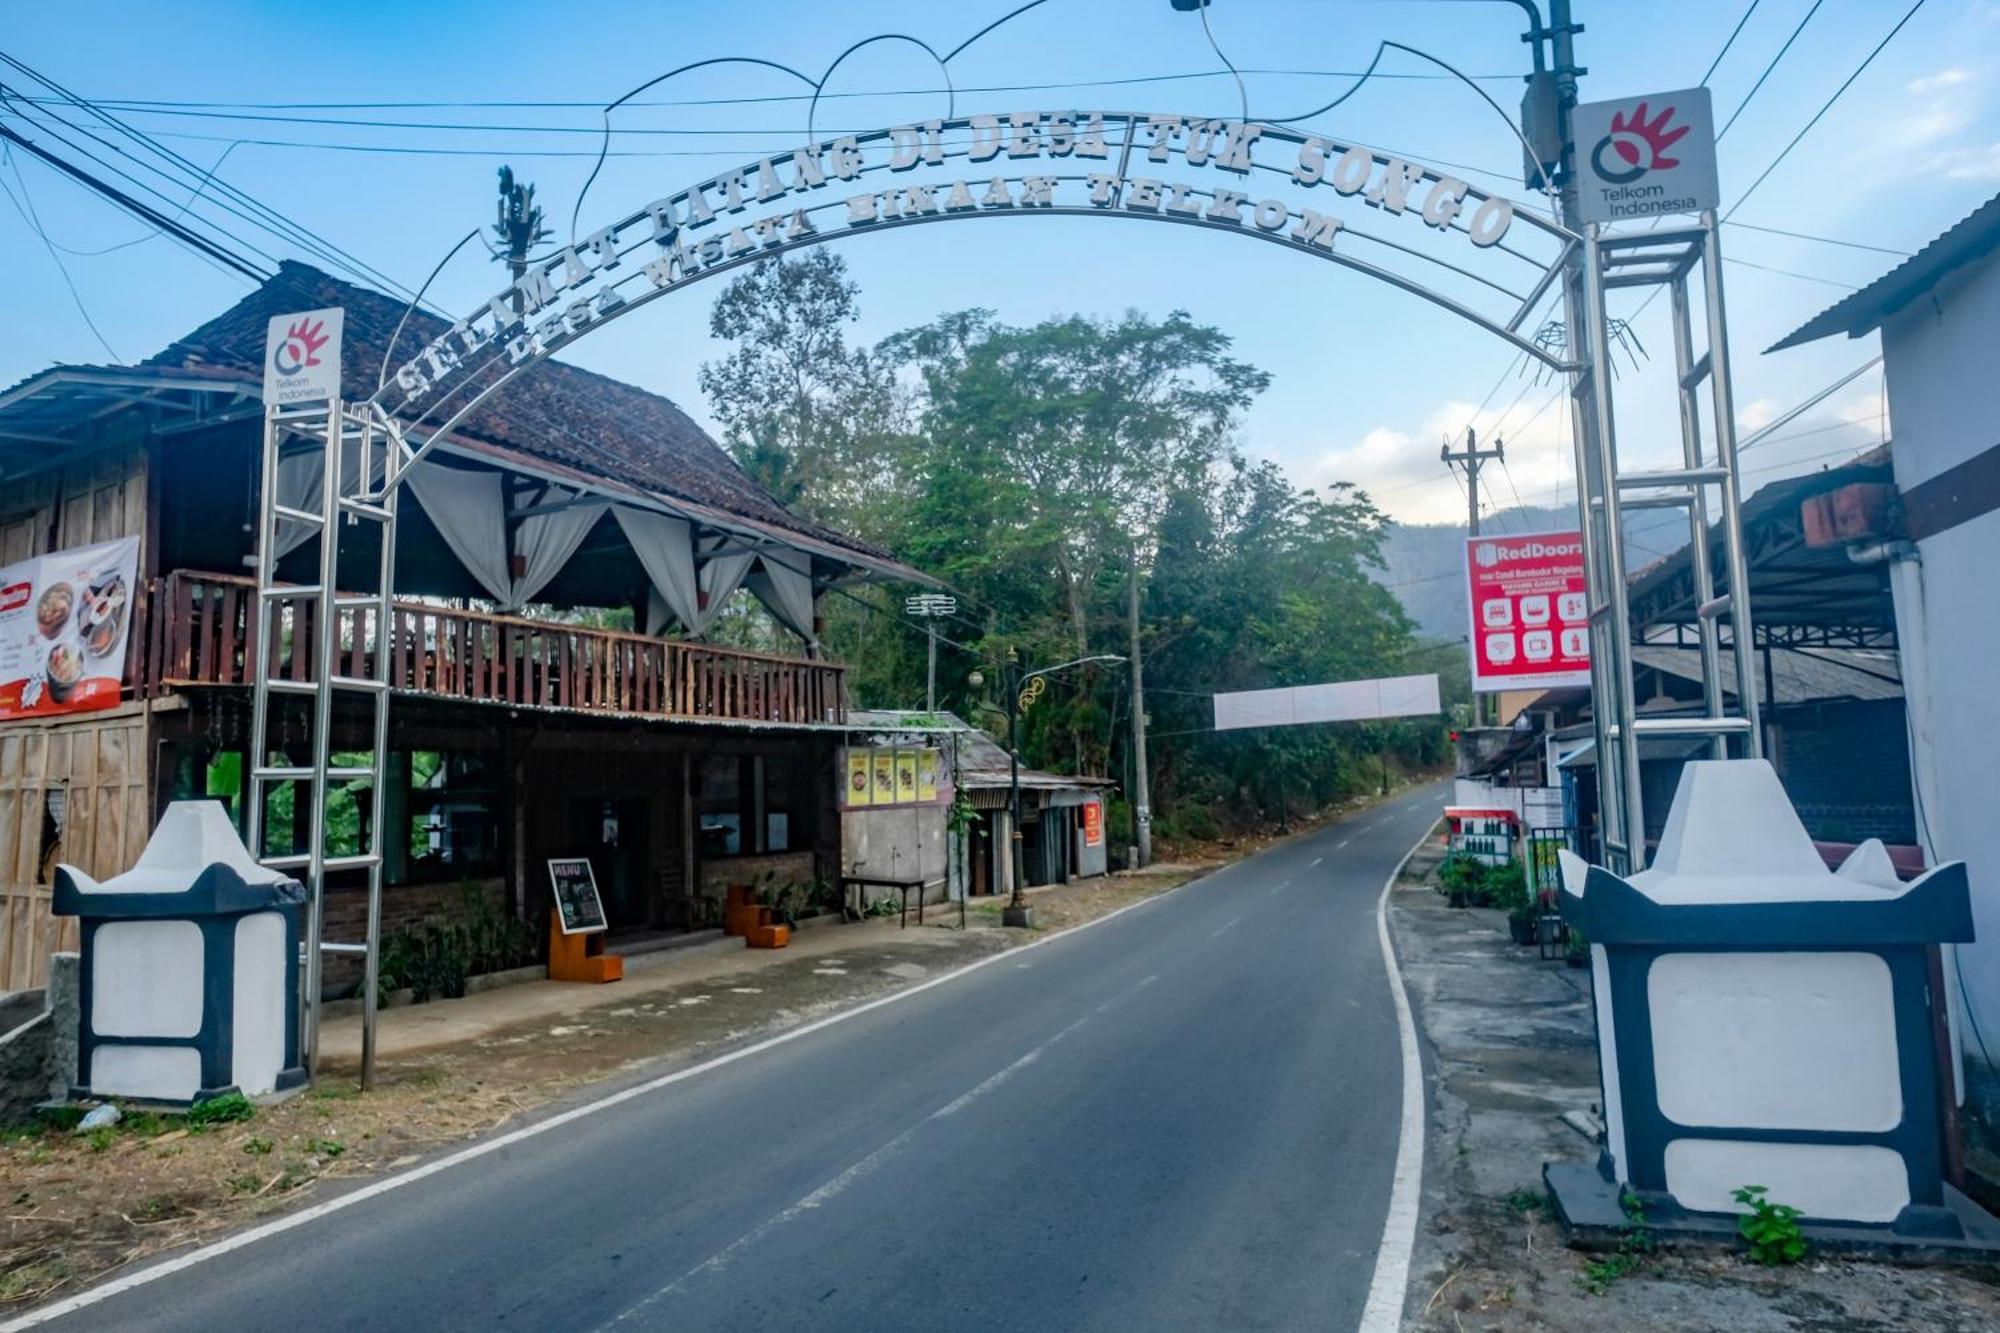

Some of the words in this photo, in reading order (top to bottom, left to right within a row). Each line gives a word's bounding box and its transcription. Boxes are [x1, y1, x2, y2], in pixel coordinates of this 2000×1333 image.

[1600, 184, 1664, 202] Telkom
[1610, 196, 1697, 217] Indonesia
[396, 225, 621, 402] SELAMAT
[643, 135, 864, 246] DATANG
[889, 118, 947, 172] DI
[967, 111, 1108, 163] DESA
[1145, 114, 1262, 175] TUK
[1291, 136, 1513, 249] SONGO
[504, 284, 627, 366] DESA
[639, 209, 819, 288] WISATA
[845, 174, 1057, 228] BINAAN
[1087, 172, 1345, 252] TELKOM
[276, 377, 310, 389] Telkom
[279, 387, 326, 400] Indonesia
